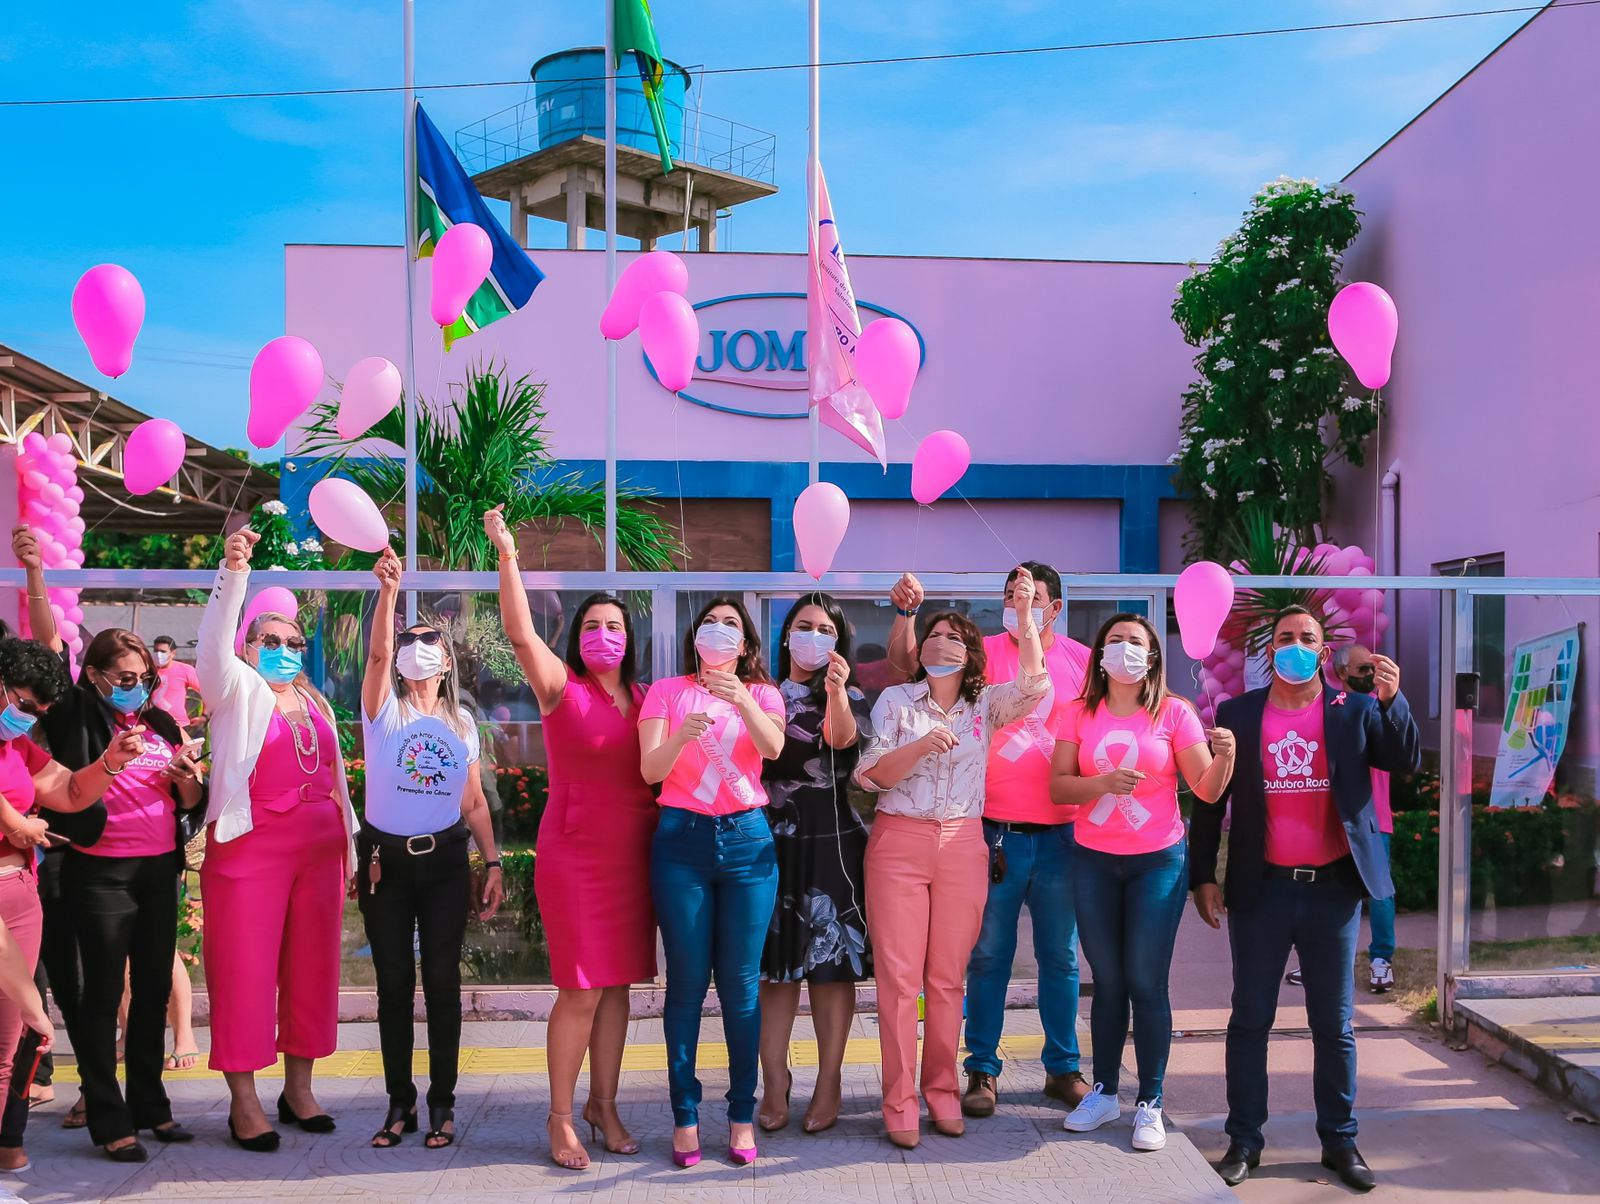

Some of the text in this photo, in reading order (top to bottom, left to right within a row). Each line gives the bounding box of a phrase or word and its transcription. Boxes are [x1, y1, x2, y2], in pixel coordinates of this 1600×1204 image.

[820, 260, 840, 283] Instituto
[127, 757, 166, 768] utubro
[397, 785, 425, 795] Prevenção
[726, 771, 750, 801] Rosa
[1264, 778, 1330, 789] Outubro Rosa
[1119, 799, 1140, 825] Rosa
